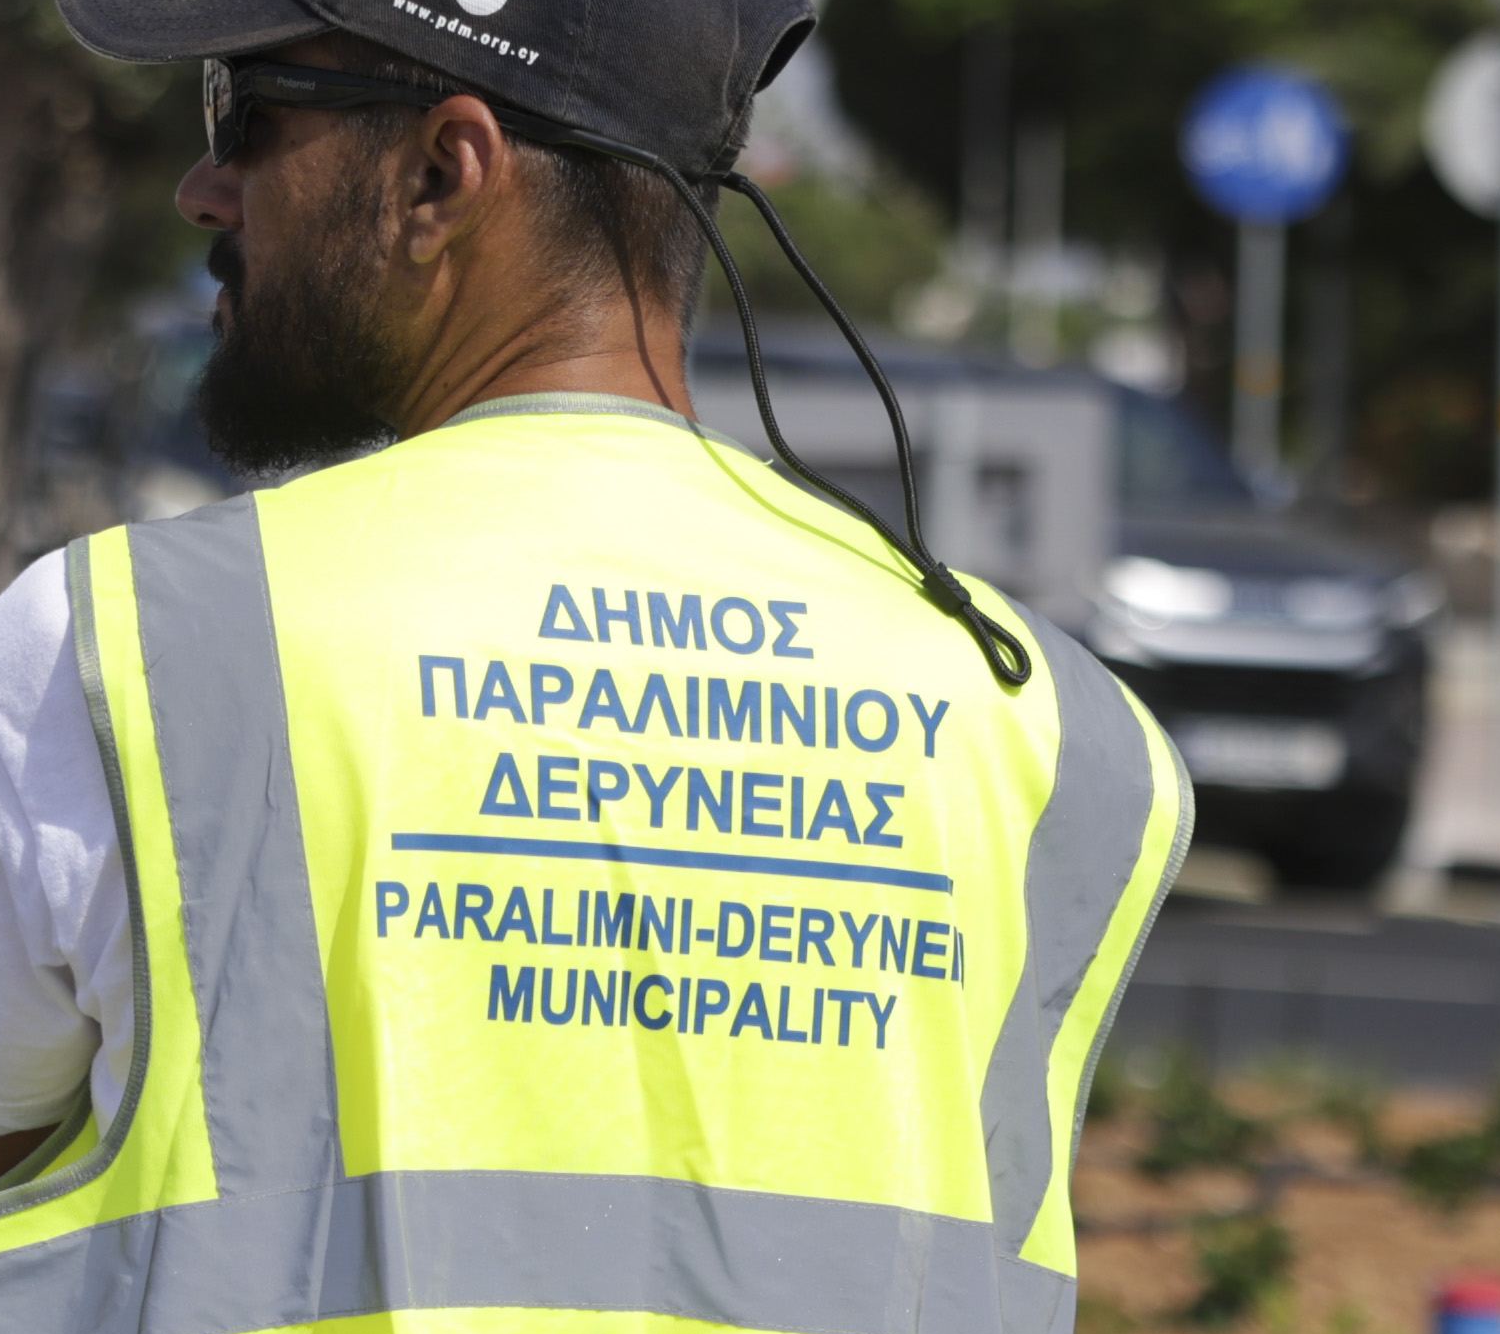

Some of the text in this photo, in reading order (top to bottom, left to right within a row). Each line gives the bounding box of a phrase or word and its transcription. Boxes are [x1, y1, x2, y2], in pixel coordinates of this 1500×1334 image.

[276, 75, 316, 92] Polaroid
[537, 582, 815, 660] ΔΗΜΟΣ
[417, 653, 951, 759] ΠΑΡΑΛΙΜΝΙΟΥ
[478, 751, 906, 849] ΔΕΡΥΝΕΙΑΣ
[373, 879, 966, 991] PARALIMNI-DERYNEI
[486, 962, 898, 1050] MUNICIPALITY
